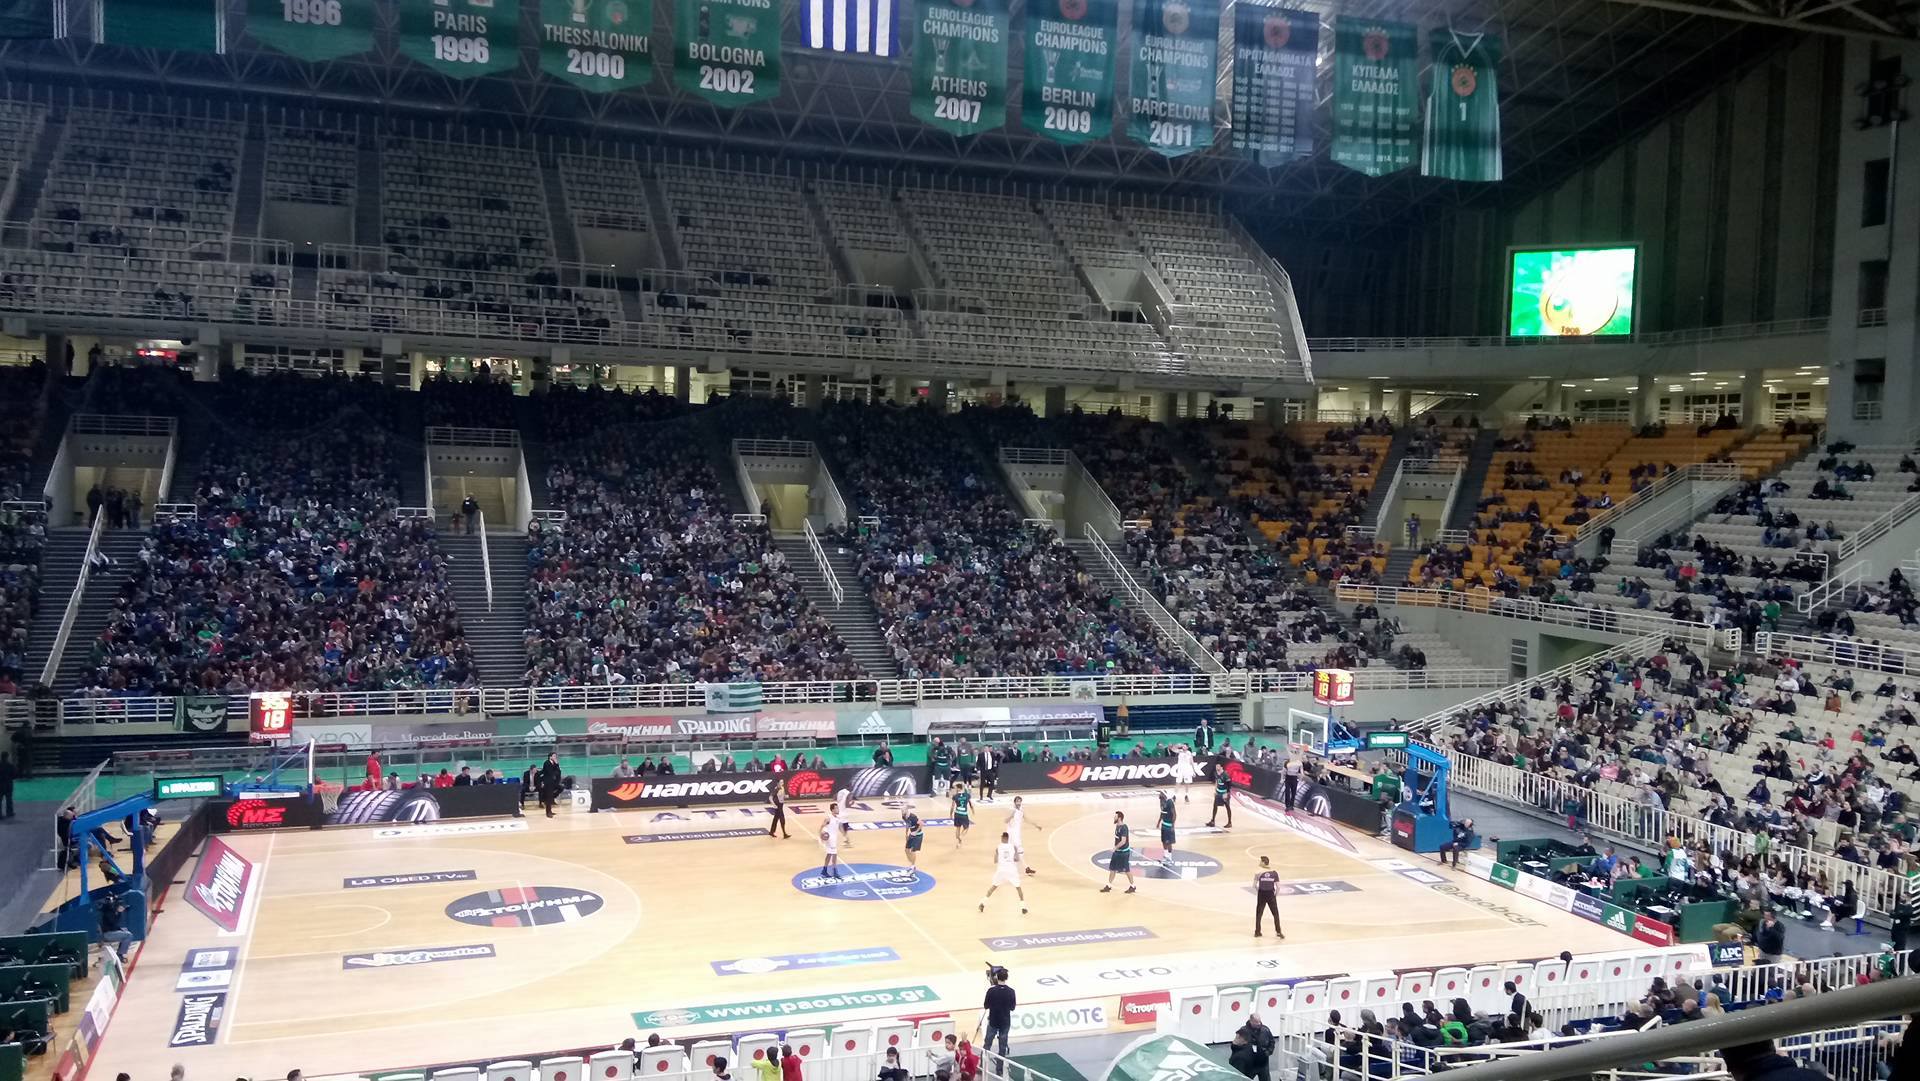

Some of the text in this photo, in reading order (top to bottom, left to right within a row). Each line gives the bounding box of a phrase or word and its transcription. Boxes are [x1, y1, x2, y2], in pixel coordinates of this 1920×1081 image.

[280, 0, 342, 26] 1996
[434, 11, 488, 34] PARIS
[928, 7, 994, 27] EUROLEAGUE
[543, 23, 649, 53] THESSALONIKI
[923, 19, 1000, 44] CHAMPIONS
[1040, 19, 1103, 39] EUROLEAGUE
[430, 35, 490, 64] 1996
[1035, 32, 1108, 56] CHAMPIONS
[1145, 35, 1205, 51] EUROLEAGUE
[566, 49, 625, 80] 2000
[689, 42, 766, 67] BOLOGNA
[1139, 47, 1209, 69] CHAMPIONS
[699, 65, 754, 94] 2002
[1255, 63, 1295, 78] ΕΛΛΑΔΟΣ
[1351, 64, 1399, 79] ΚΥΠΕΛΛΑ
[931, 76, 988, 97] ATHENS
[1042, 86, 1096, 108] BERLIN
[1351, 79, 1399, 95] ΕΛΛΑΔΟΣ
[934, 95, 982, 124] 2007
[1044, 106, 1091, 134] 2009
[1132, 98, 1210, 121] BARCELONA
[1459, 102, 1467, 122] 1
[1149, 120, 1192, 146] 2011
[678, 717, 751, 735] SPALDING
[658, 828, 764, 841] Mercedes-Benz
[351, 878, 377, 886] LG
[1295, 883, 1333, 891] LG
[1023, 928, 1148, 946] Mercedes-Benz
[1720, 947, 1743, 959] APC
[705, 987, 926, 1018] www.paoshop.gr
[171, 994, 219, 1045] SPALDING
